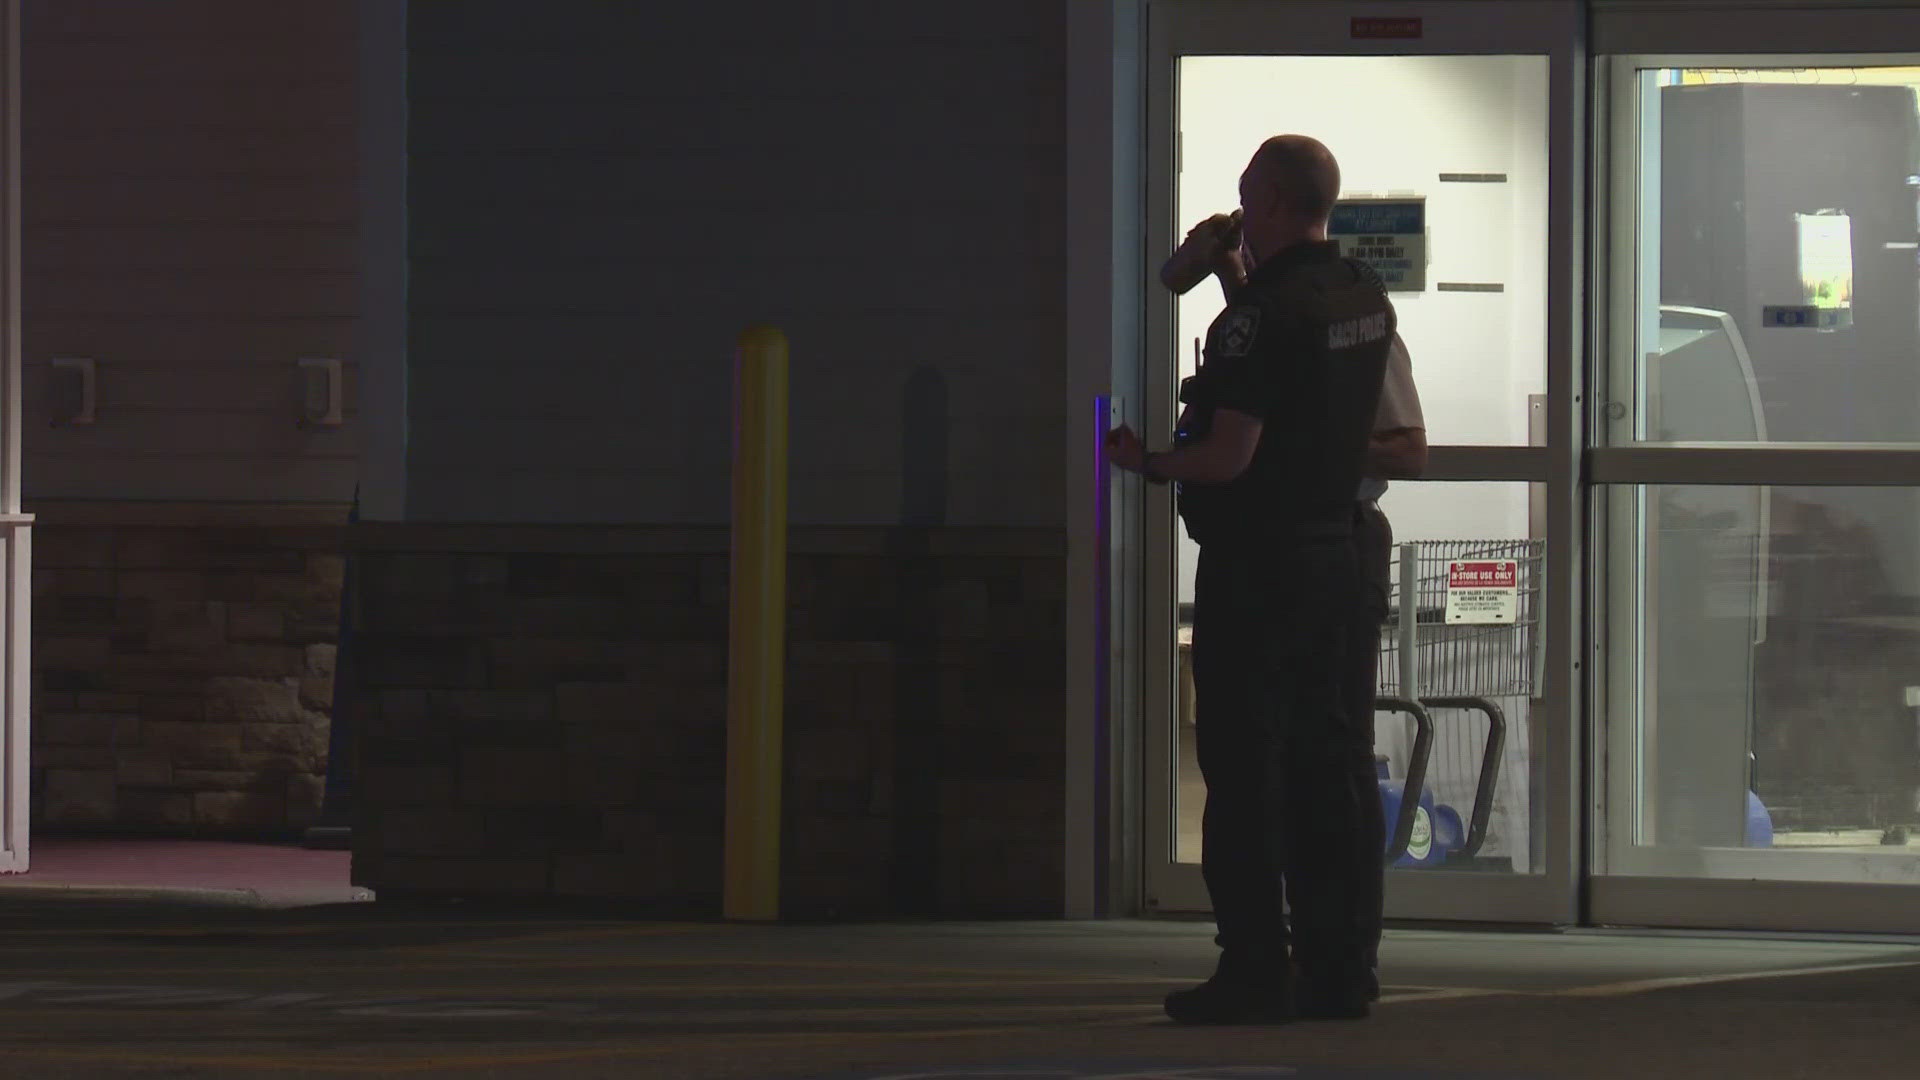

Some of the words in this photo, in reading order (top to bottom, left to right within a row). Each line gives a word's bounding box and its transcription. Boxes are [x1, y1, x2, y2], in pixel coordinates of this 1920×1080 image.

[1329, 321, 1357, 349] SACO
[1360, 313, 1385, 342] POLICE
[1451, 571, 1478, 580] IN-STORE
[1480, 571, 1493, 580] USE
[1495, 571, 1512, 580] ONLY
